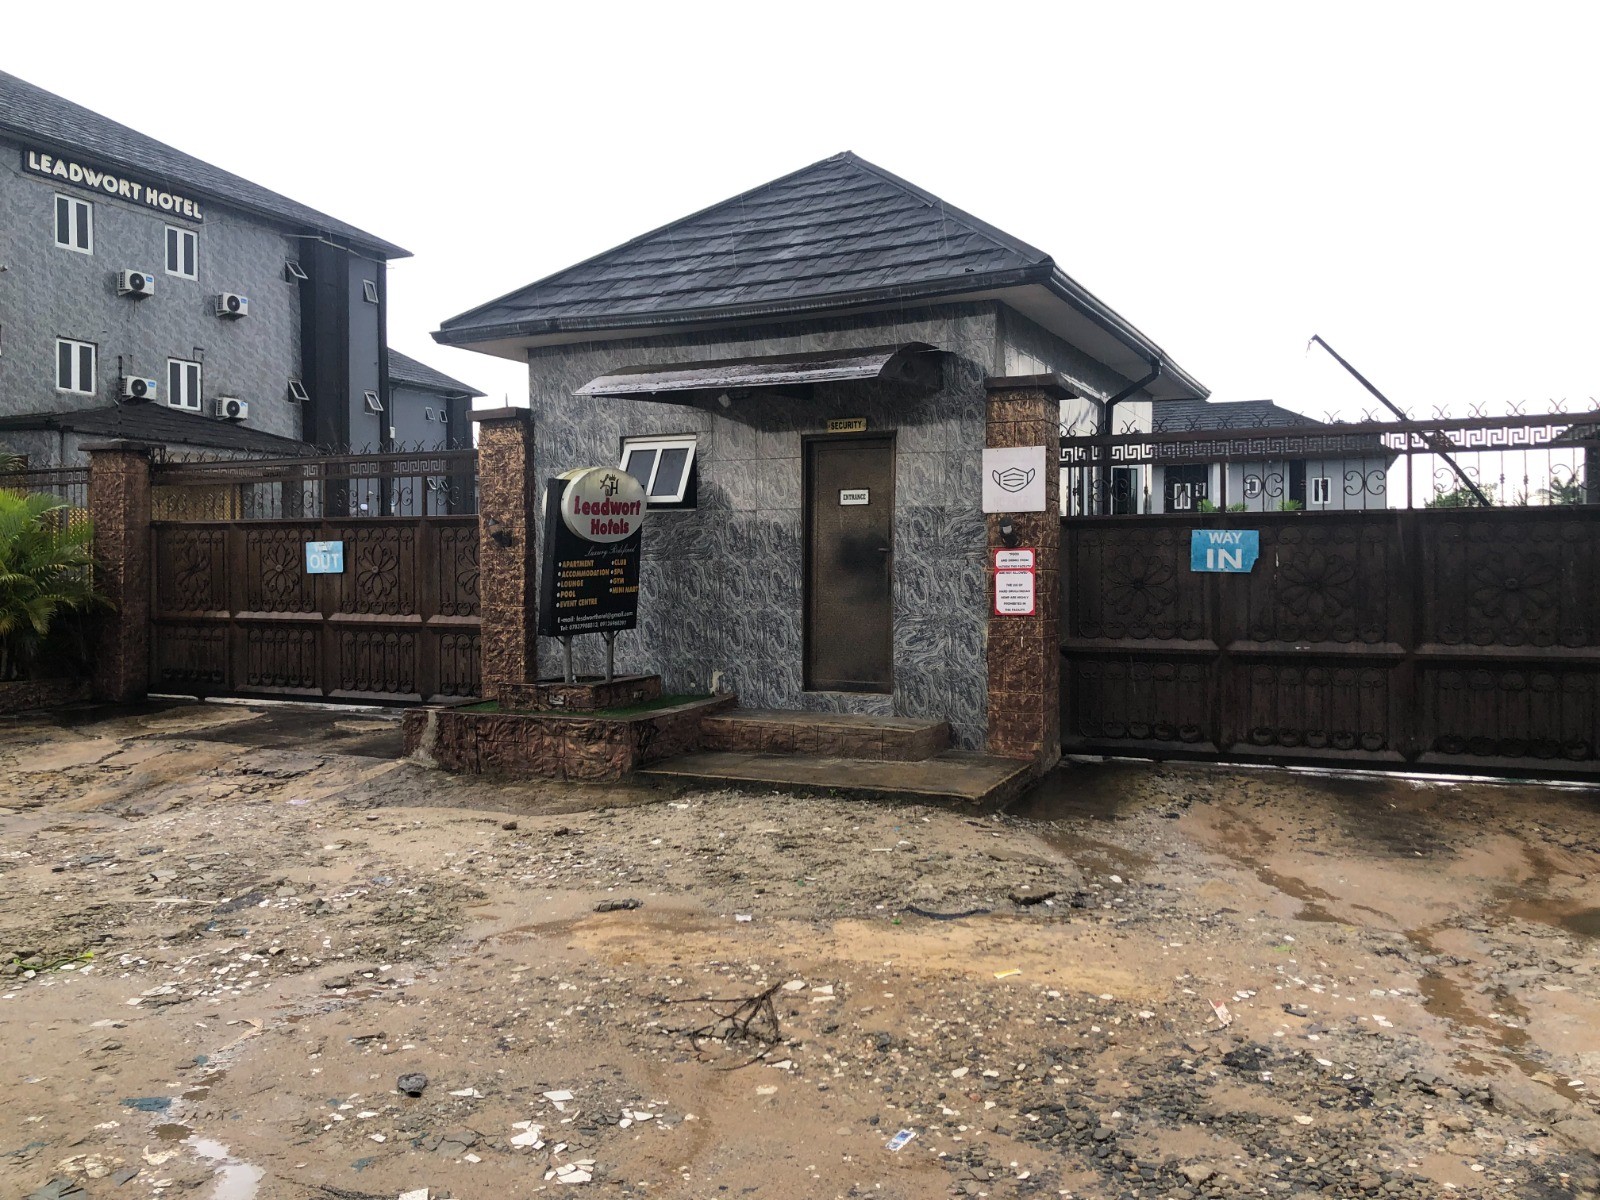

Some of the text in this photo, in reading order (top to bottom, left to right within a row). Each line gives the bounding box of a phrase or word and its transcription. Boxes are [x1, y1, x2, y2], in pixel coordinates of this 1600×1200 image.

[29, 151, 202, 219] LEADWORT HOTEL
[830, 420, 863, 430] SECURITY
[574, 495, 642, 516] Leadwort
[591, 518, 629, 535] Hotels
[1208, 532, 1243, 544] WAY
[310, 553, 339, 569] OUT
[562, 560, 595, 568] APARTMENT
[1206, 548, 1243, 569] IN
[562, 569, 610, 578] ACCOMMODATION
[560, 580, 584, 588] LOUNGE
[560, 590, 576, 598] POOL
[560, 598, 598, 608] EVENT CENTRE
